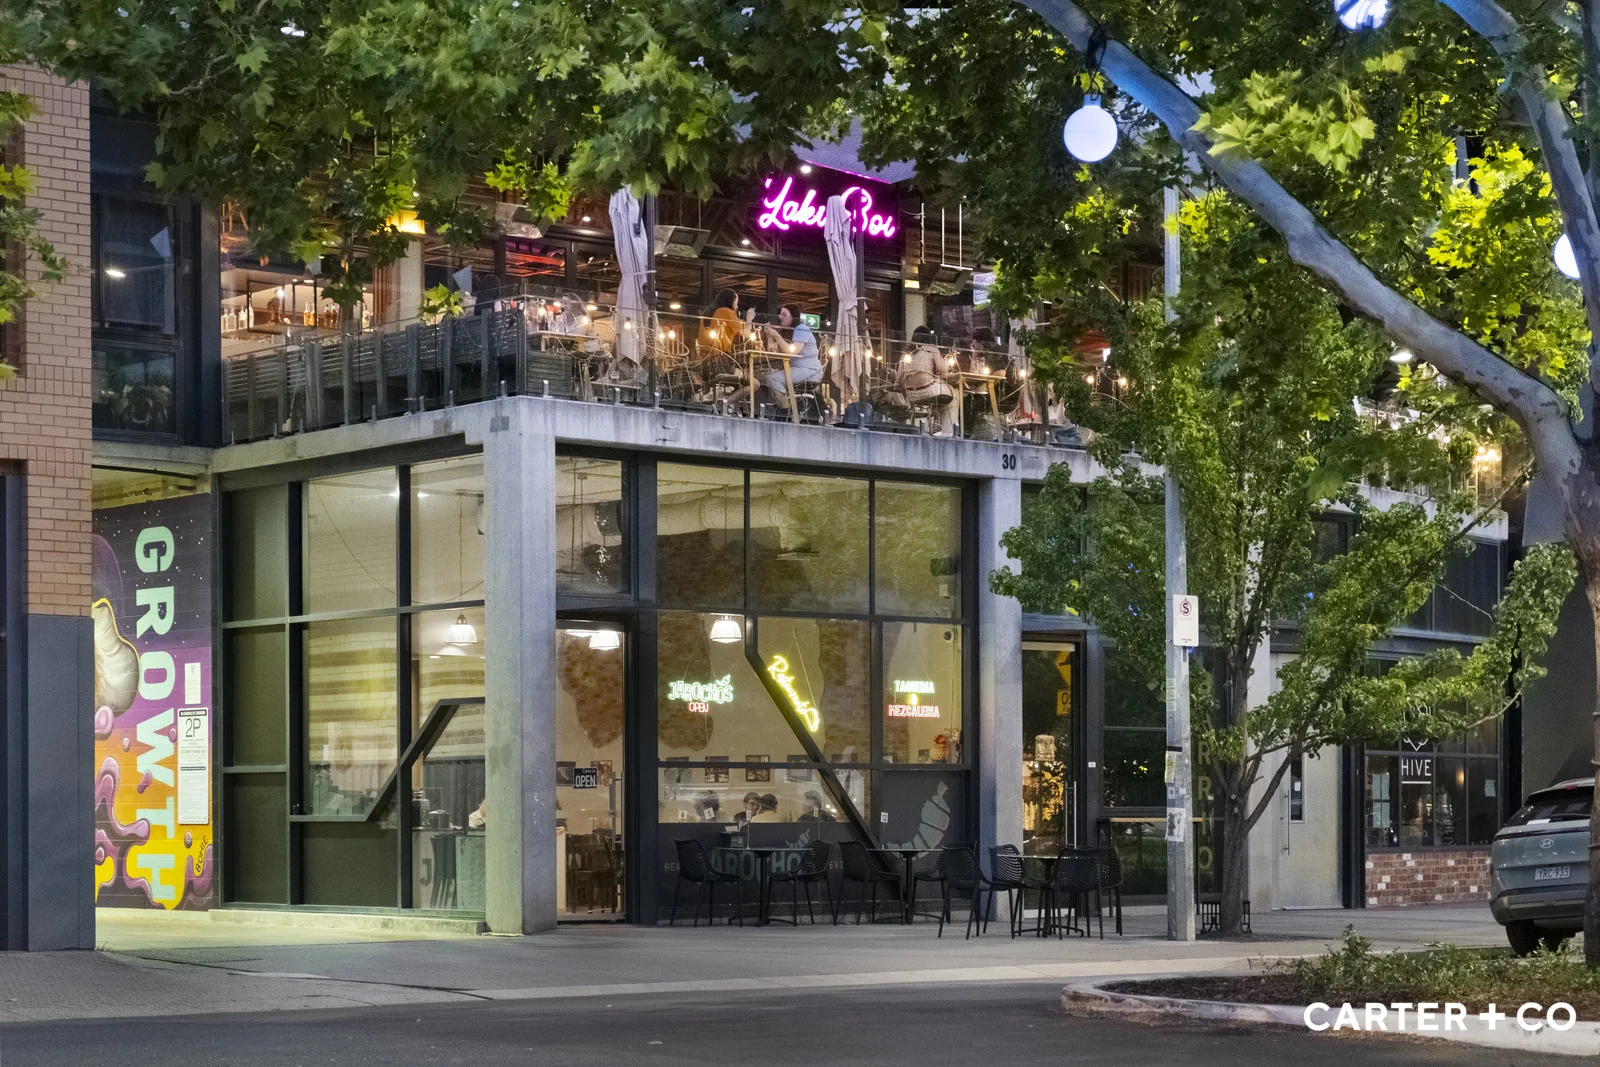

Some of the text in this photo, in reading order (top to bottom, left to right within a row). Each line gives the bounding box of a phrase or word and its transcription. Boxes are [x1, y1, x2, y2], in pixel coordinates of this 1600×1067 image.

[1002, 453, 1016, 470] 30
[668, 680, 734, 704] JAROCHOS
[894, 679, 935, 694] TAQUERIA
[135, 525, 176, 901] GROWTH
[689, 701, 709, 713] OPEN
[888, 704, 940, 718] MEZCALERIA
[185, 717, 202, 738] 2P
[1401, 758, 1432, 777] HIVE
[575, 774, 596, 788] OPEN
